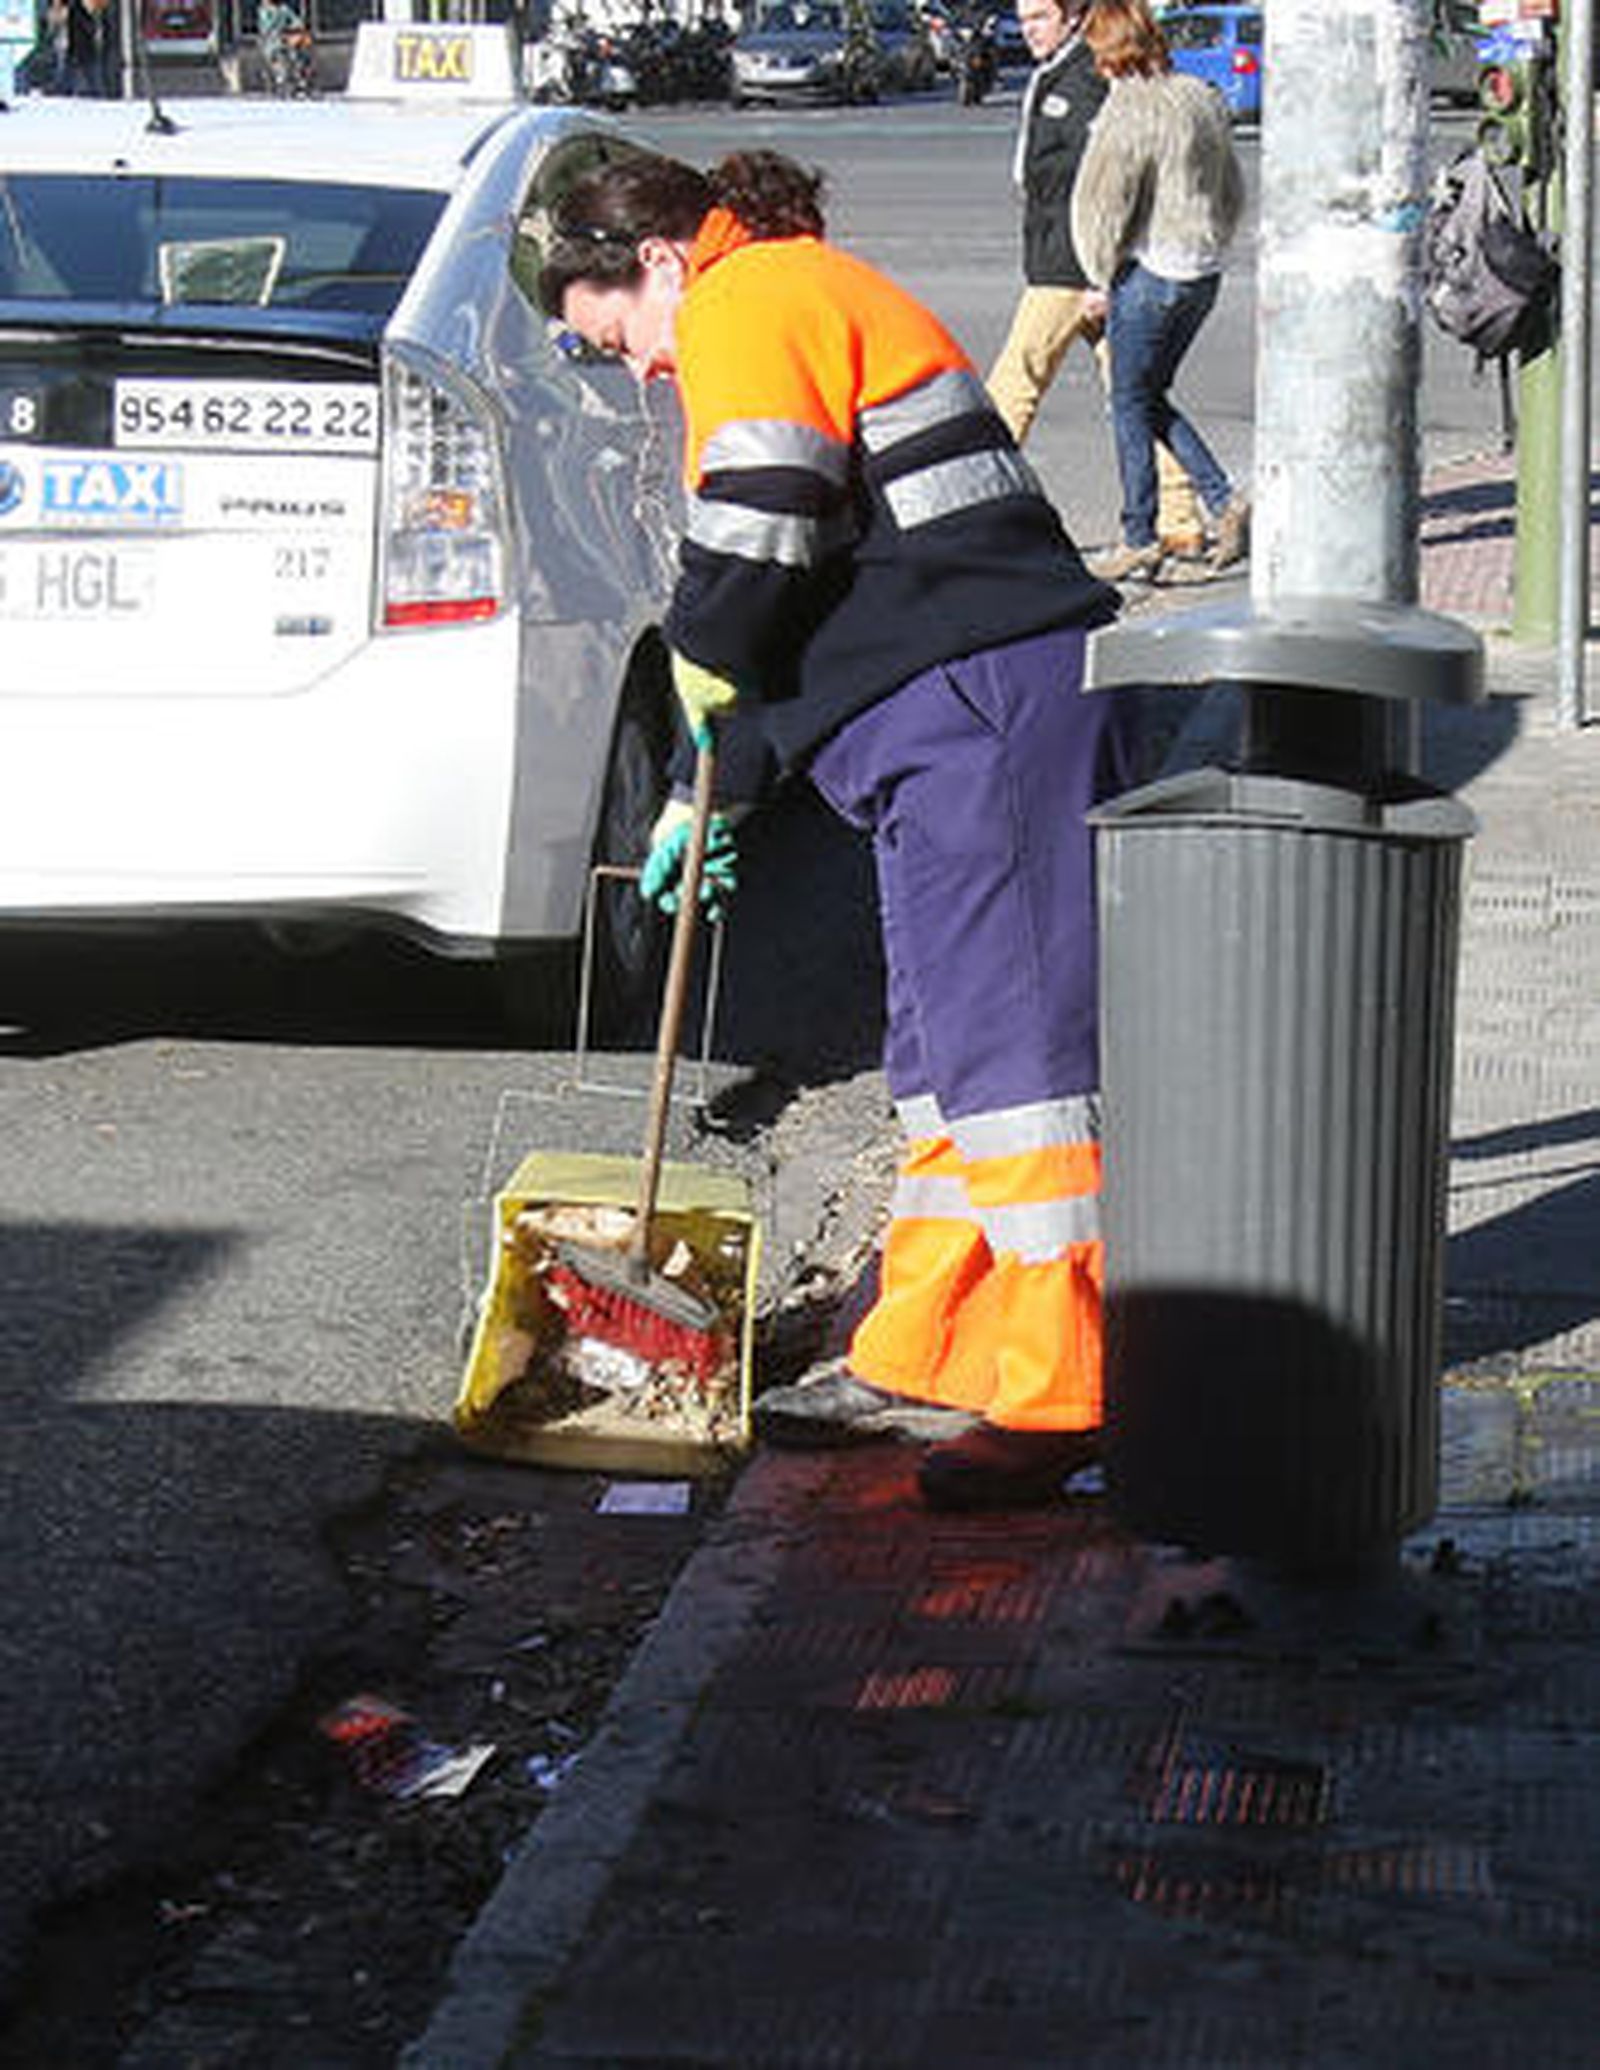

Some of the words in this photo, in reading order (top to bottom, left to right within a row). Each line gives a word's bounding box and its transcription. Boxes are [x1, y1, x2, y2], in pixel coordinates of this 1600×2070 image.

[394, 34, 472, 81] TAXI
[120, 396, 194, 433] 954
[202, 397, 251, 433] 62
[263, 399, 312, 436] 22
[323, 400, 372, 438] 22
[44, 462, 178, 510] TAXI
[37, 552, 141, 610] HGL
